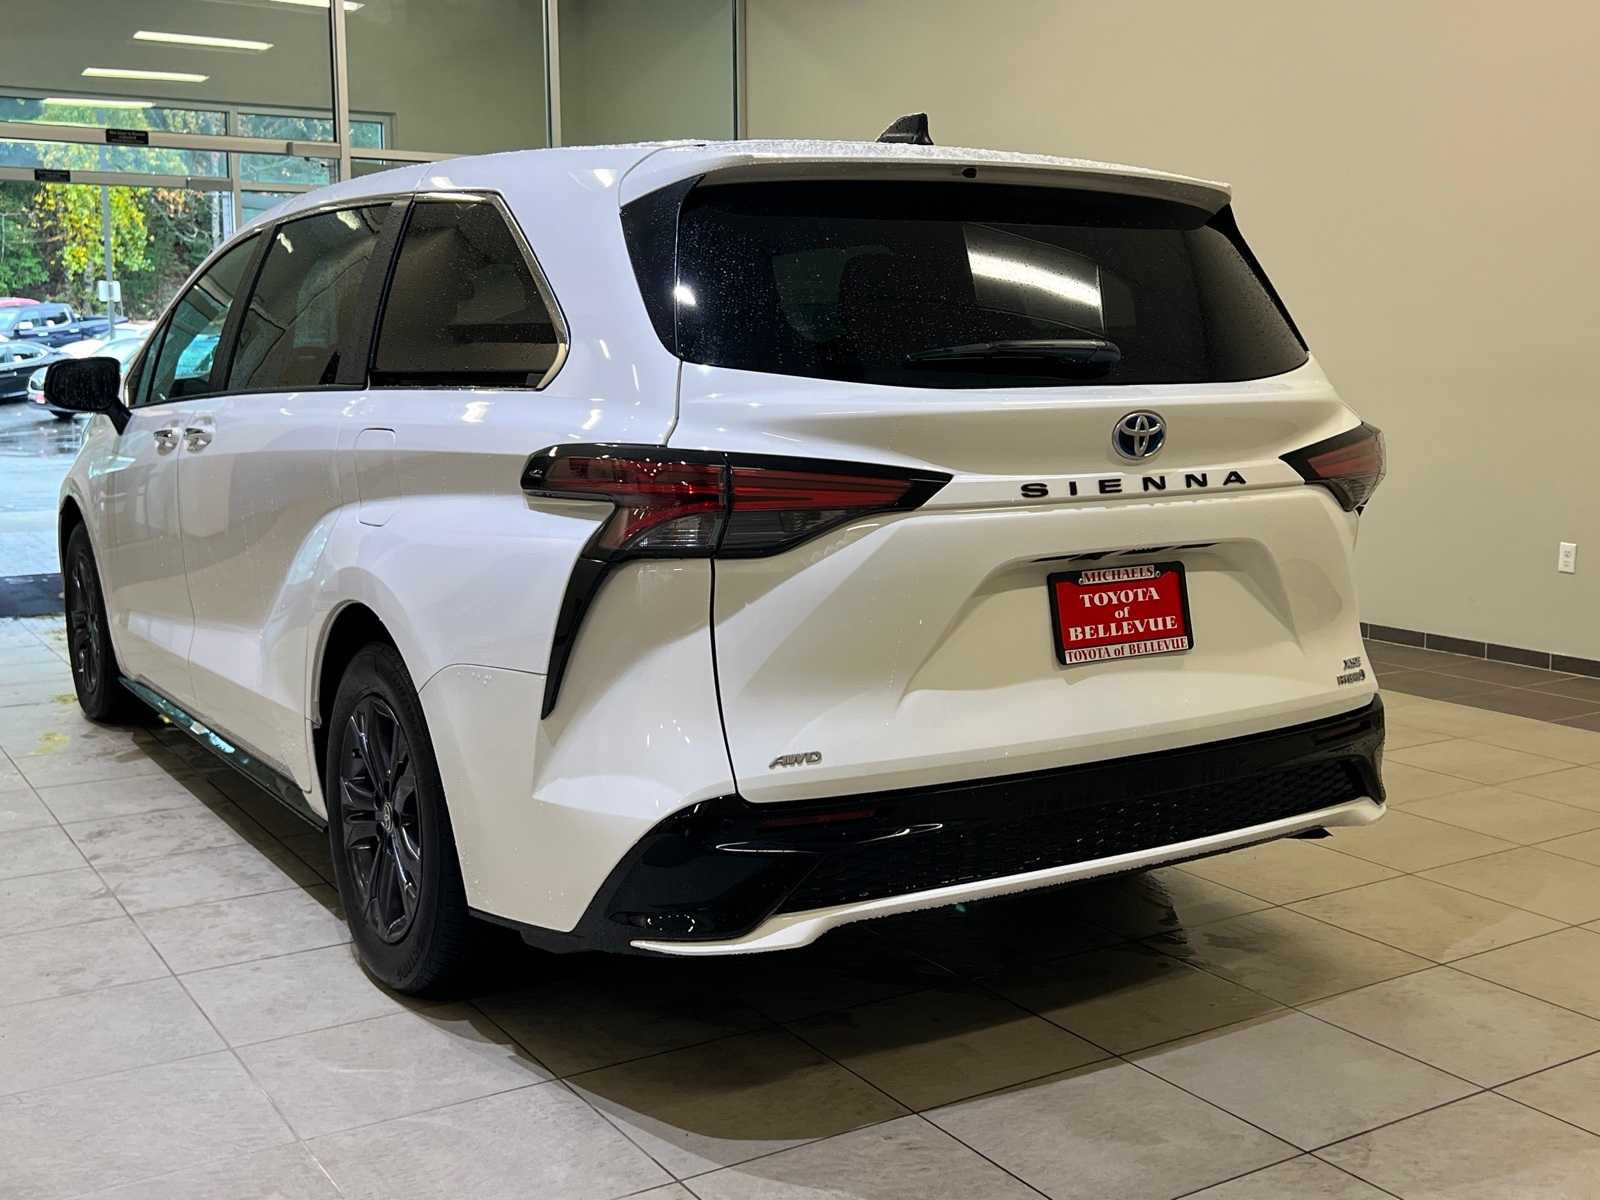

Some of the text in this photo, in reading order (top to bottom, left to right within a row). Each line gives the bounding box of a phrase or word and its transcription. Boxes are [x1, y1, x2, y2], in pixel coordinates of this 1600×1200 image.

[1020, 470, 1247, 498] SIENNA
[1082, 567, 1154, 583] MICHAELS
[1080, 587, 1160, 608] TOYOTA
[1114, 607, 1130, 619] of
[1068, 616, 1178, 642] BELLEVUE
[1067, 637, 1188, 663] TOYOTA of BELLEVUE
[768, 751, 822, 769] AWD
